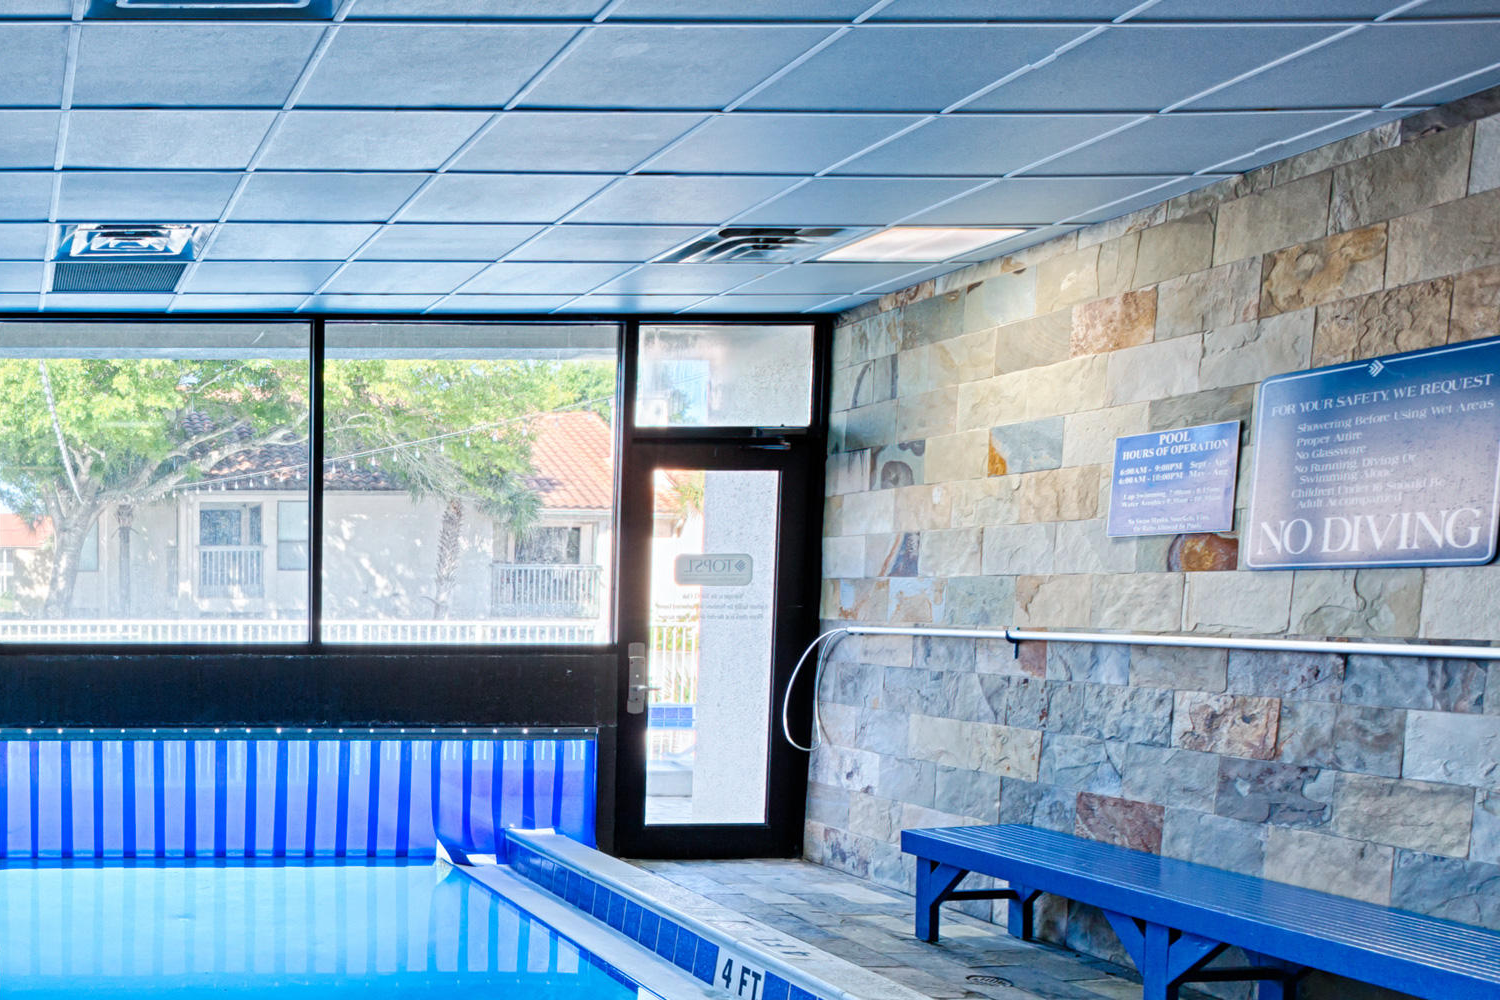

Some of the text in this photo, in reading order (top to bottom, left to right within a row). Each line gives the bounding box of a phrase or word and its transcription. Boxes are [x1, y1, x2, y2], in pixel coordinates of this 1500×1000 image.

[1271, 403, 1296, 417] FOR
[1299, 398, 1334, 412] YOUR
[1393, 385, 1417, 398] WE
[1420, 374, 1494, 396] REQUEST
[1297, 399, 1495, 433] Showering Before Using Wet Areas
[1159, 431, 1192, 445] POOL
[1296, 431, 1363, 448] Proper Attire
[1122, 438, 1230, 461] HOURS OF OPERATION
[1295, 444, 1368, 460] No Glassware
[1293, 464, 1308, 474] No
[1362, 453, 1399, 467] Diving
[1299, 469, 1359, 485] Swimming
[1291, 486, 1335, 499] Children
[1257, 508, 1483, 556] NO DIVING
[722, 958, 733, 990] 4
